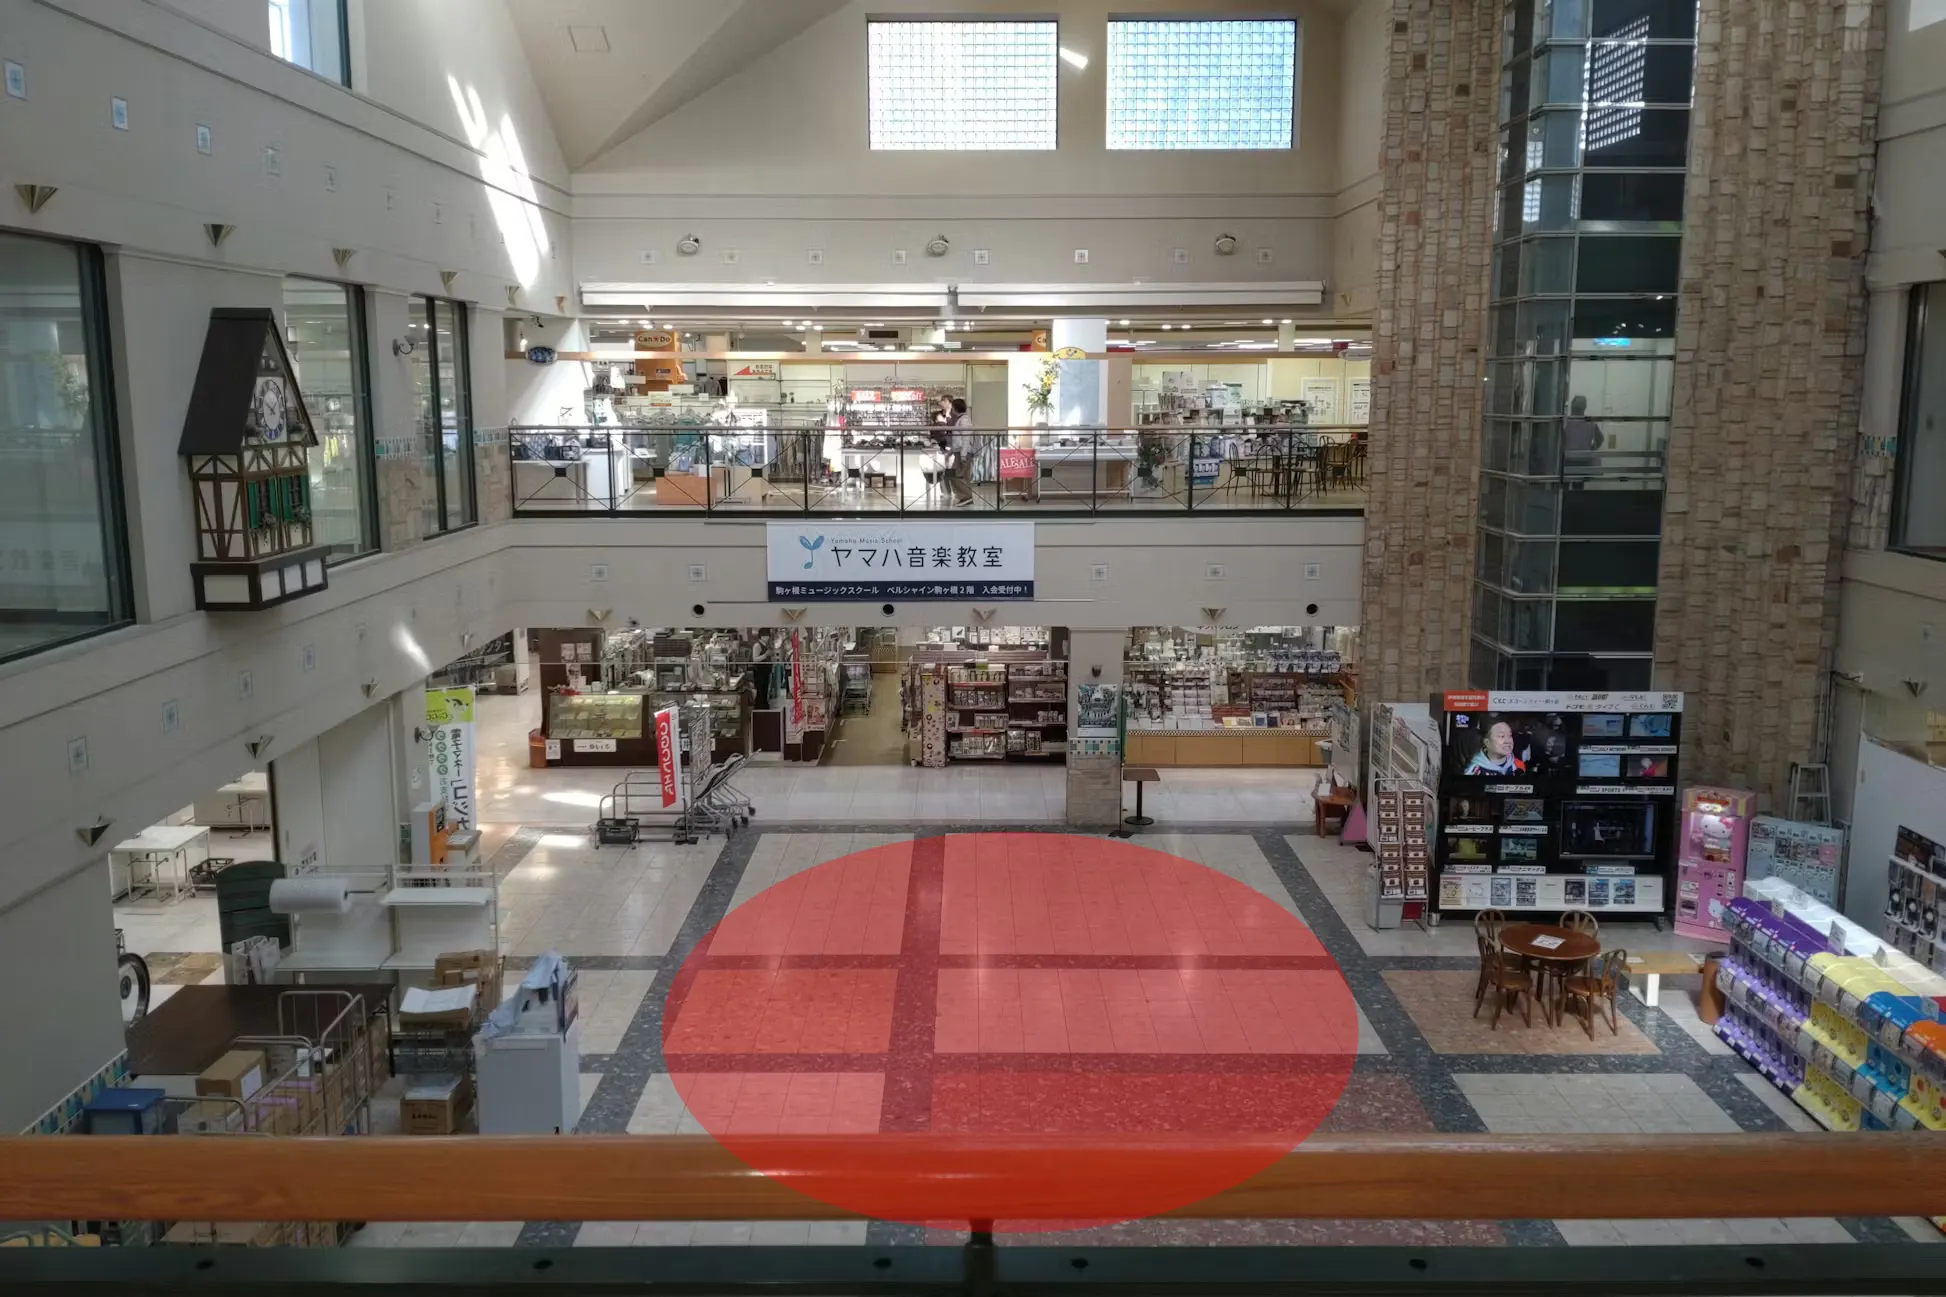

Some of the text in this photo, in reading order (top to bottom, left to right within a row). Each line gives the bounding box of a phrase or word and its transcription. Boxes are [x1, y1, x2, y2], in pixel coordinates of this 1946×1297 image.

[831, 546, 1003, 568] ヤマハ音楽教室
[775, 586, 879, 595] 駒ヶ根ミュージックスクール
